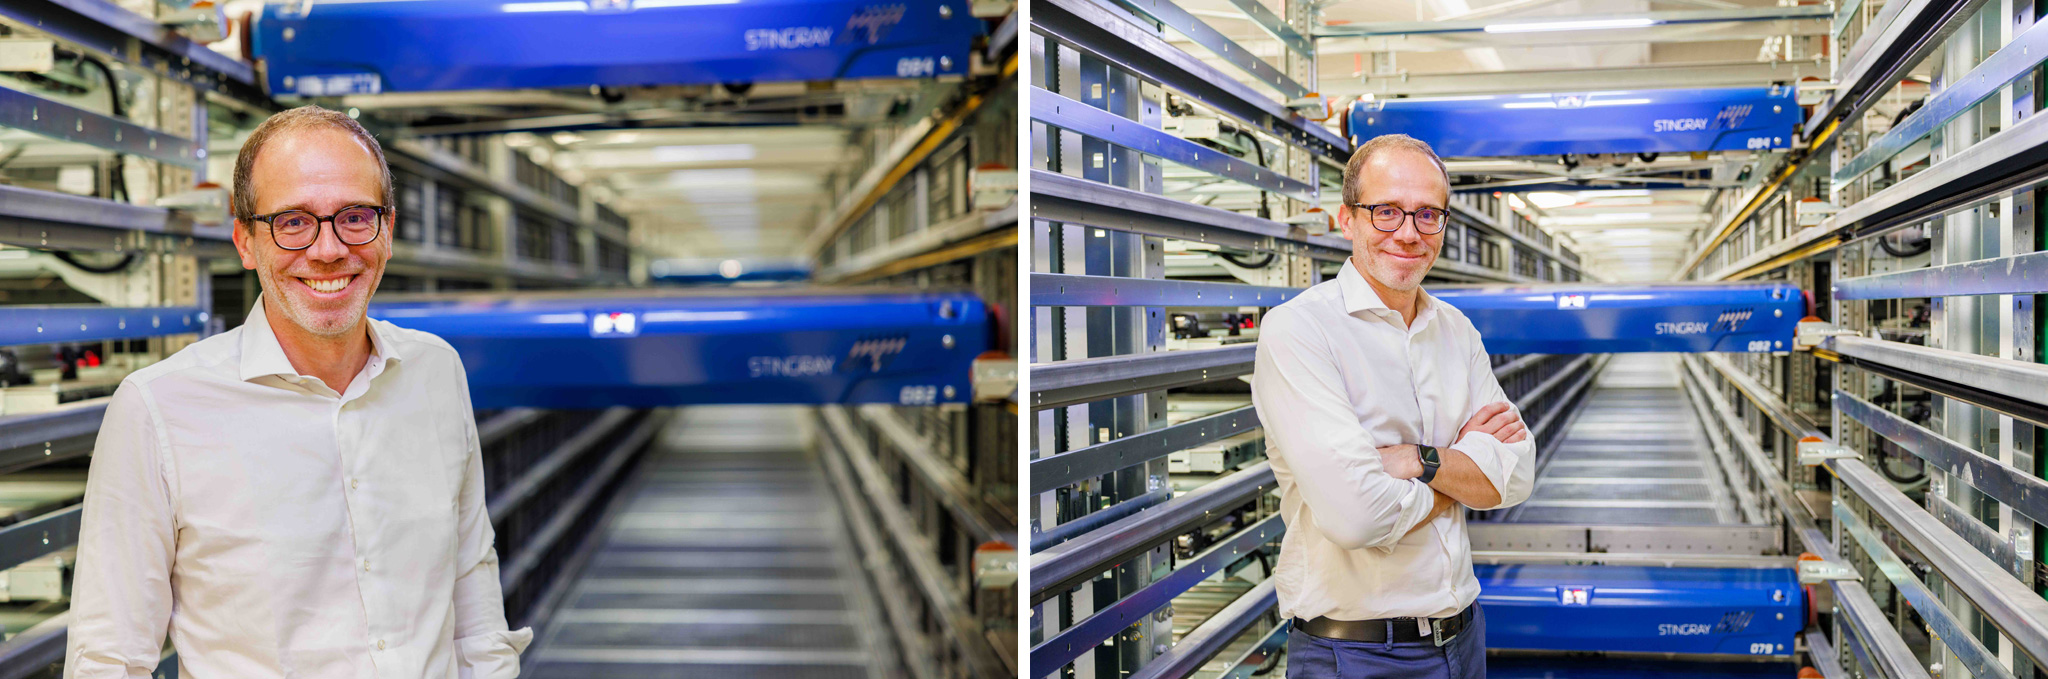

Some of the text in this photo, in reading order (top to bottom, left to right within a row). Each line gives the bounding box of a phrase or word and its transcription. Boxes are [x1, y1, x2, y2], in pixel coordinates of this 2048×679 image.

[744, 27, 833, 50] STINGRAY
[1653, 118, 1708, 132] STINGRAY
[1654, 322, 1709, 335] STINGRAY
[748, 355, 836, 377] STINGRAY
[1658, 624, 1711, 636] STINGRAY
[1750, 643, 1773, 654] 079
